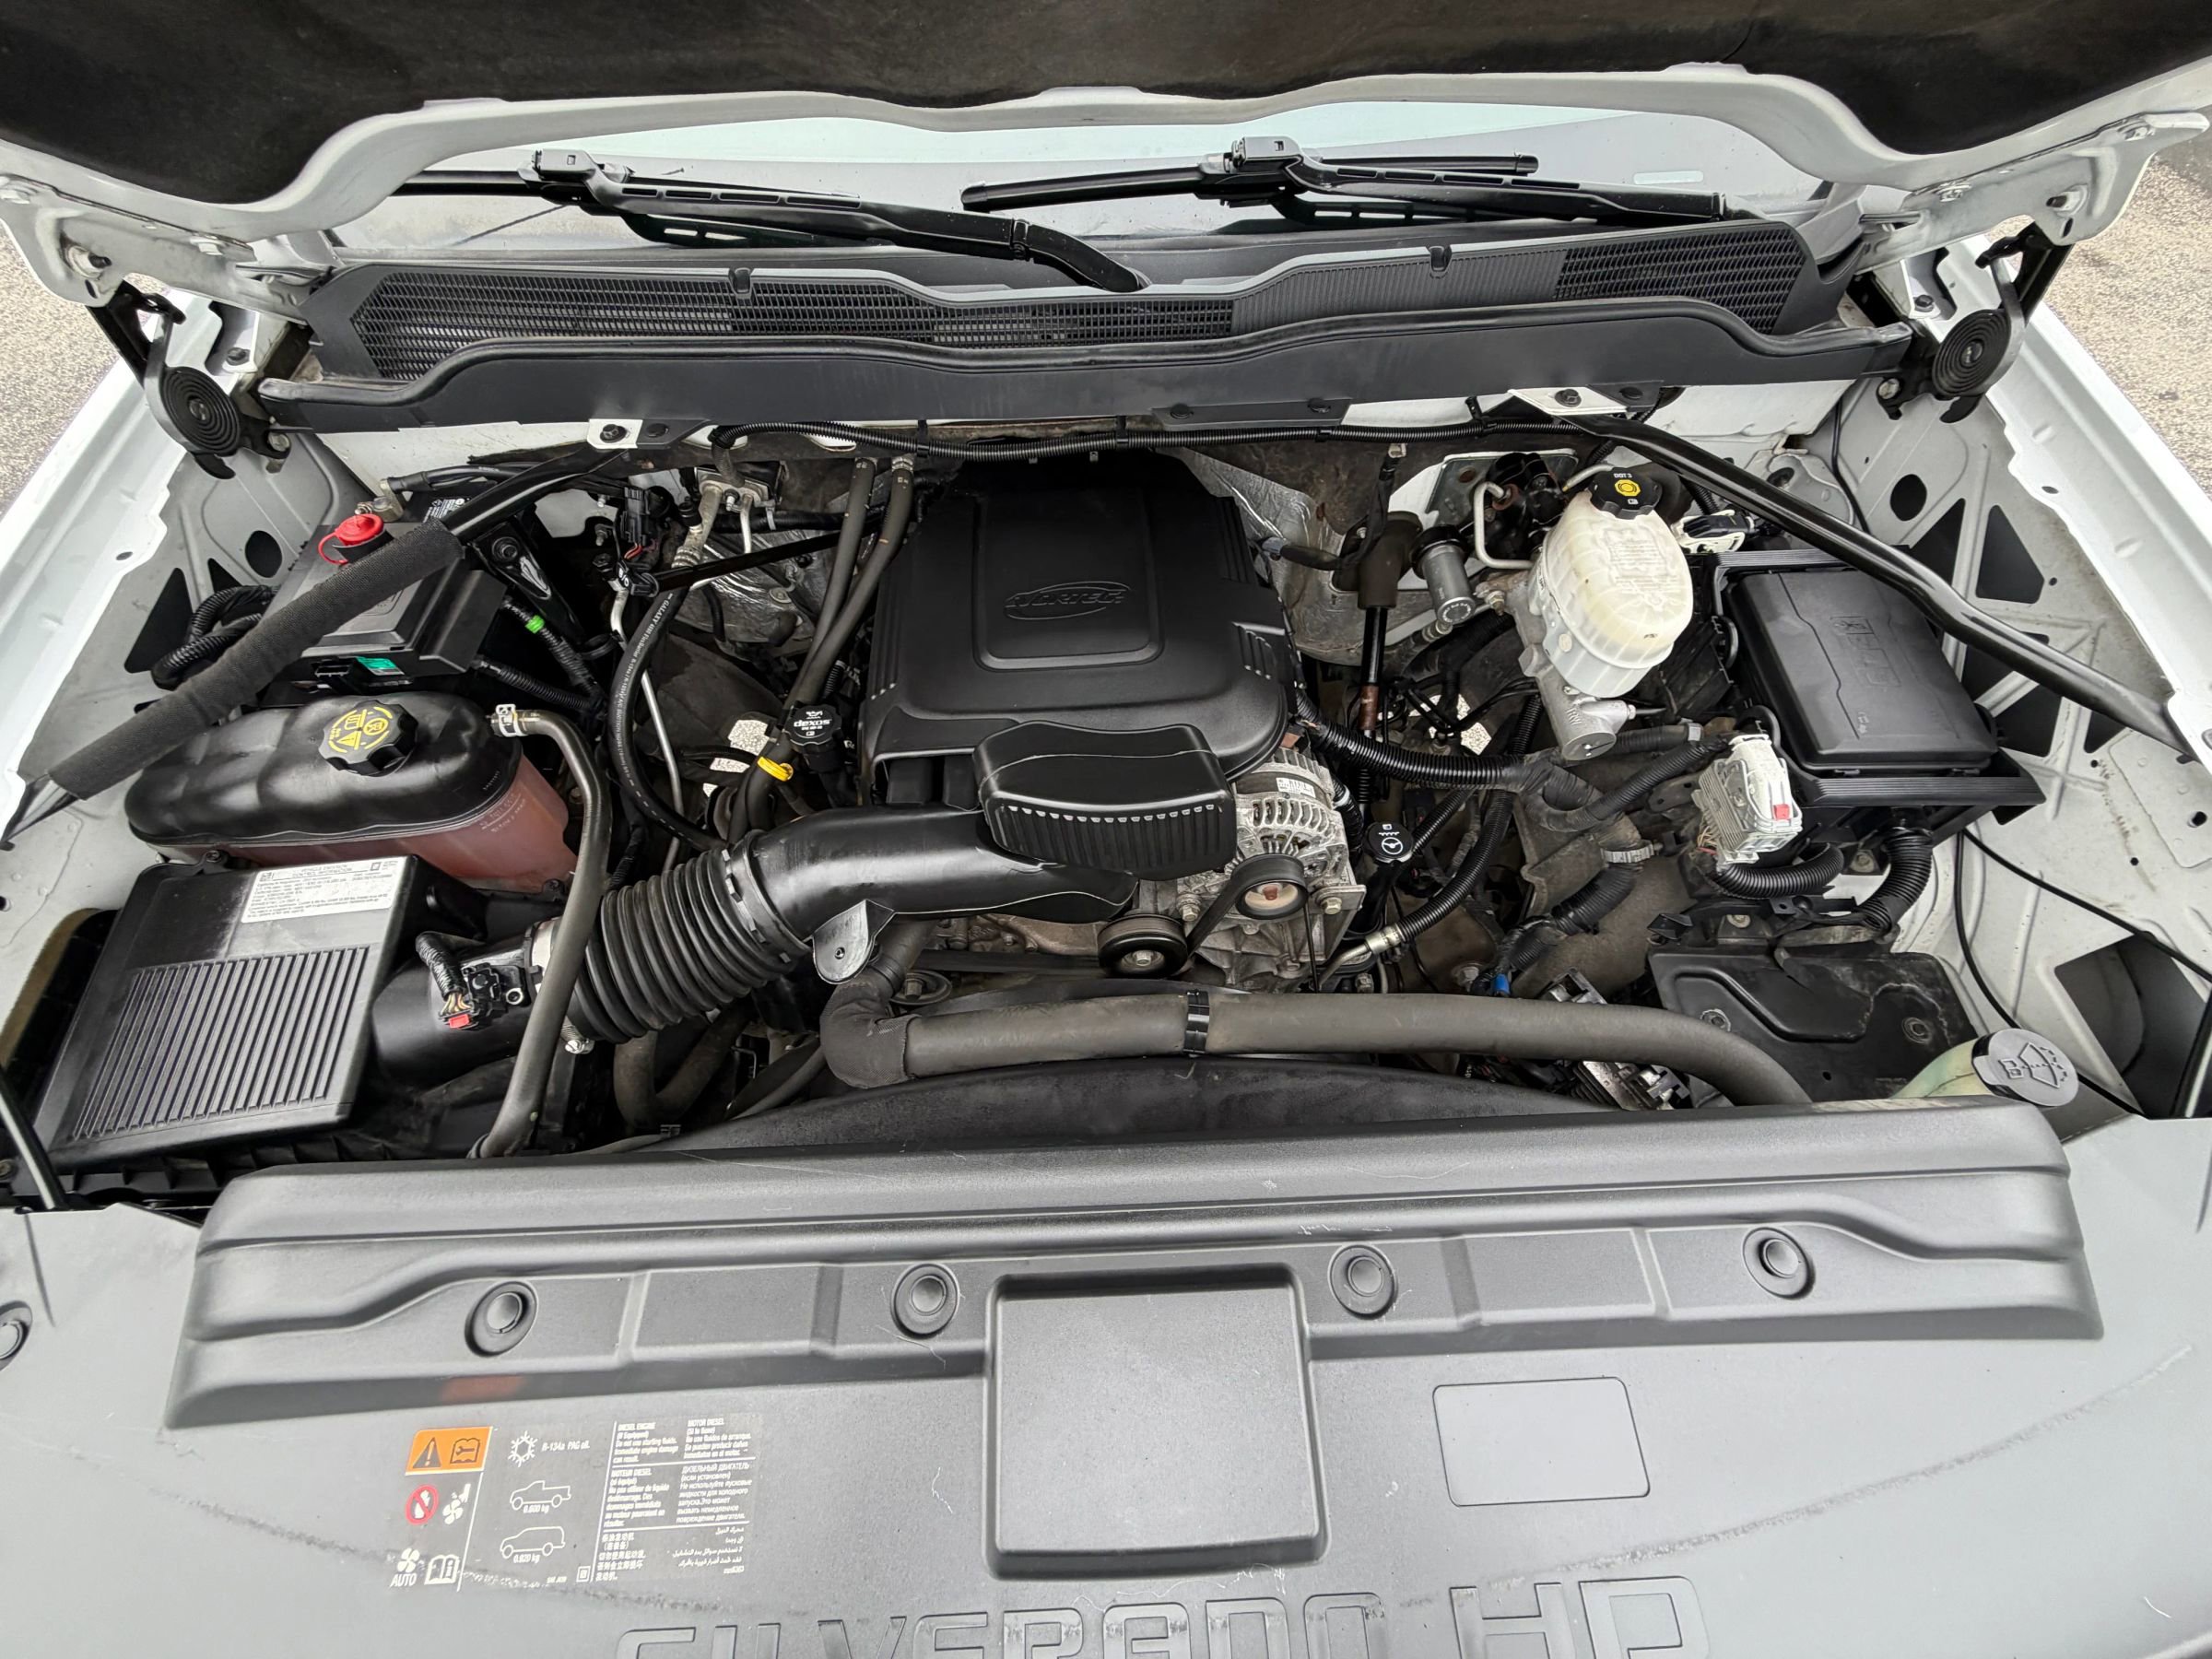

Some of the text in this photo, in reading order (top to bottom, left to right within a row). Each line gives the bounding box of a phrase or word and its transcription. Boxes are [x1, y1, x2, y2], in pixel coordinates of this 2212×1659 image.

[653, 599, 670, 623] GALAXY
[794, 719, 830, 727] dexos
[390, 1573, 417, 1587] AUTO
[1450, 1576, 1711, 1659] HD
